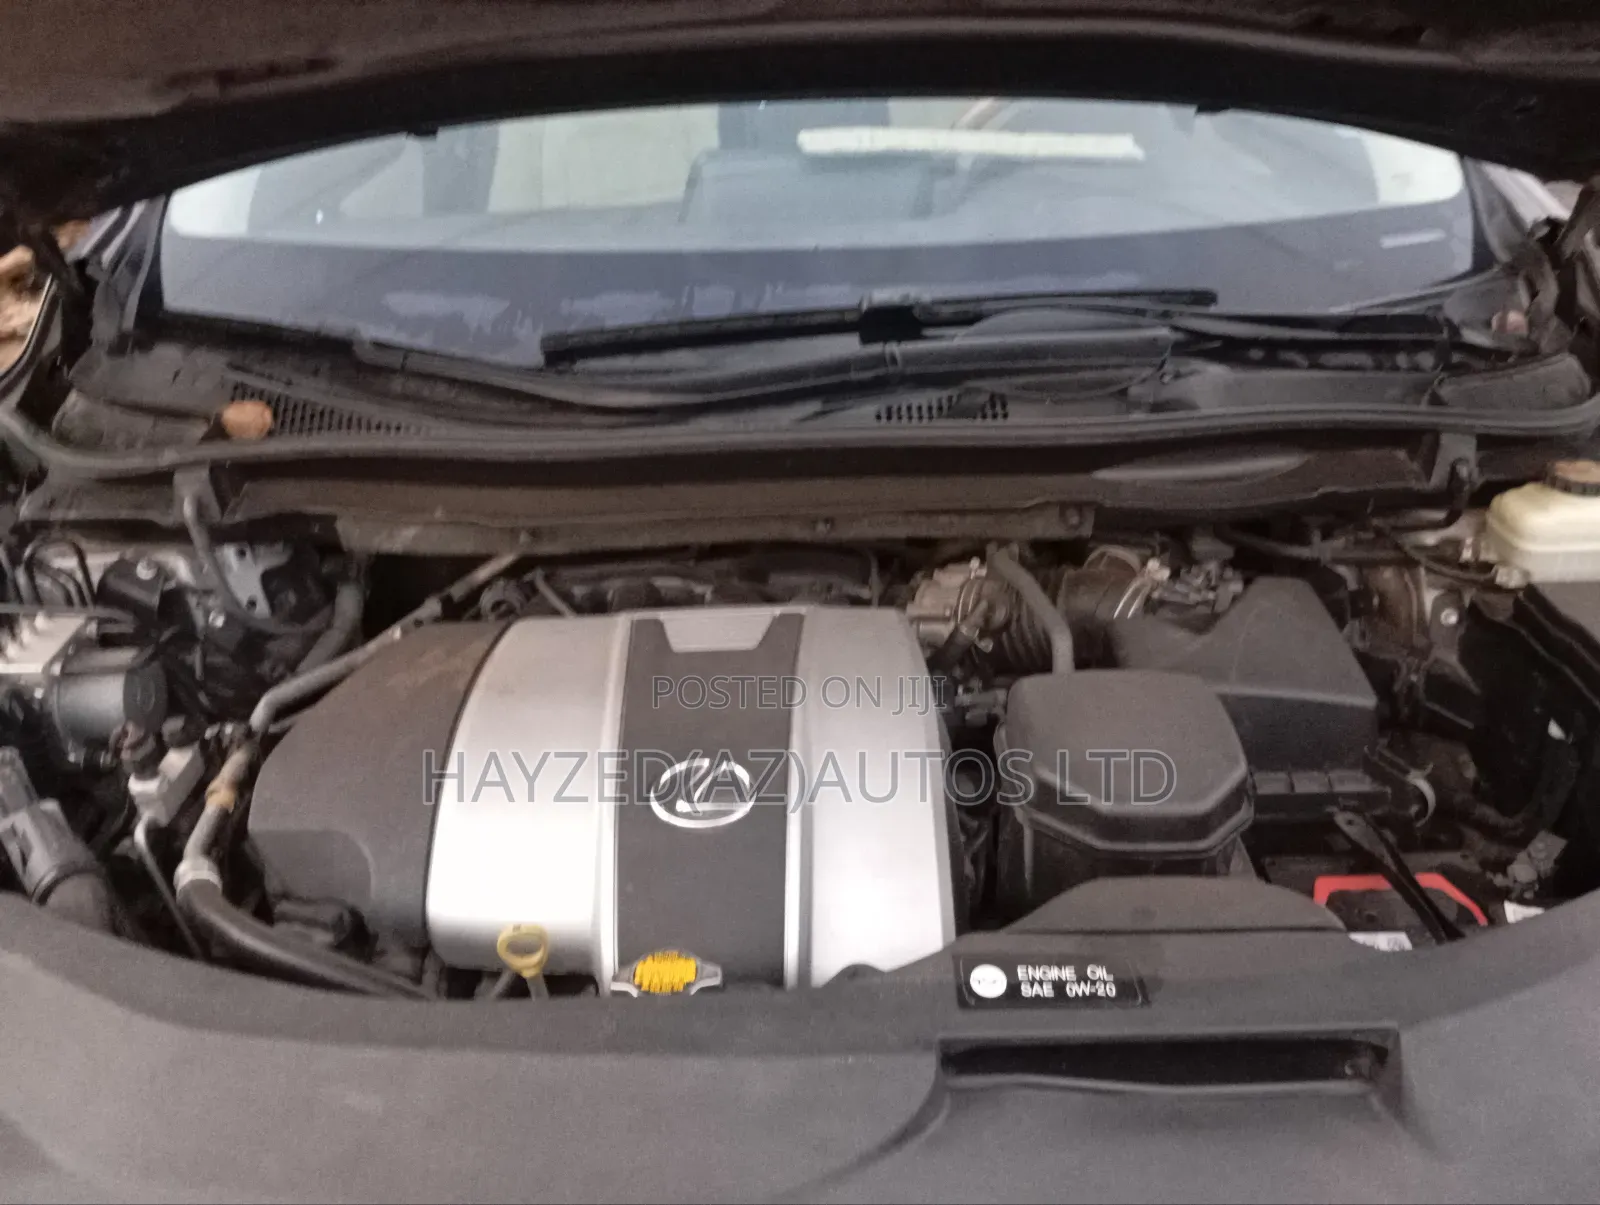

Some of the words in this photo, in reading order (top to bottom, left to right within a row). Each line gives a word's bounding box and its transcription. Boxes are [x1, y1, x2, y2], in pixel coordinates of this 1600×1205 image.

[1017, 964, 1076, 981] ENGINE
[1086, 964, 1113, 981] OIL
[1020, 981, 1054, 997] SAE
[1065, 980, 1116, 997] 0W-20
